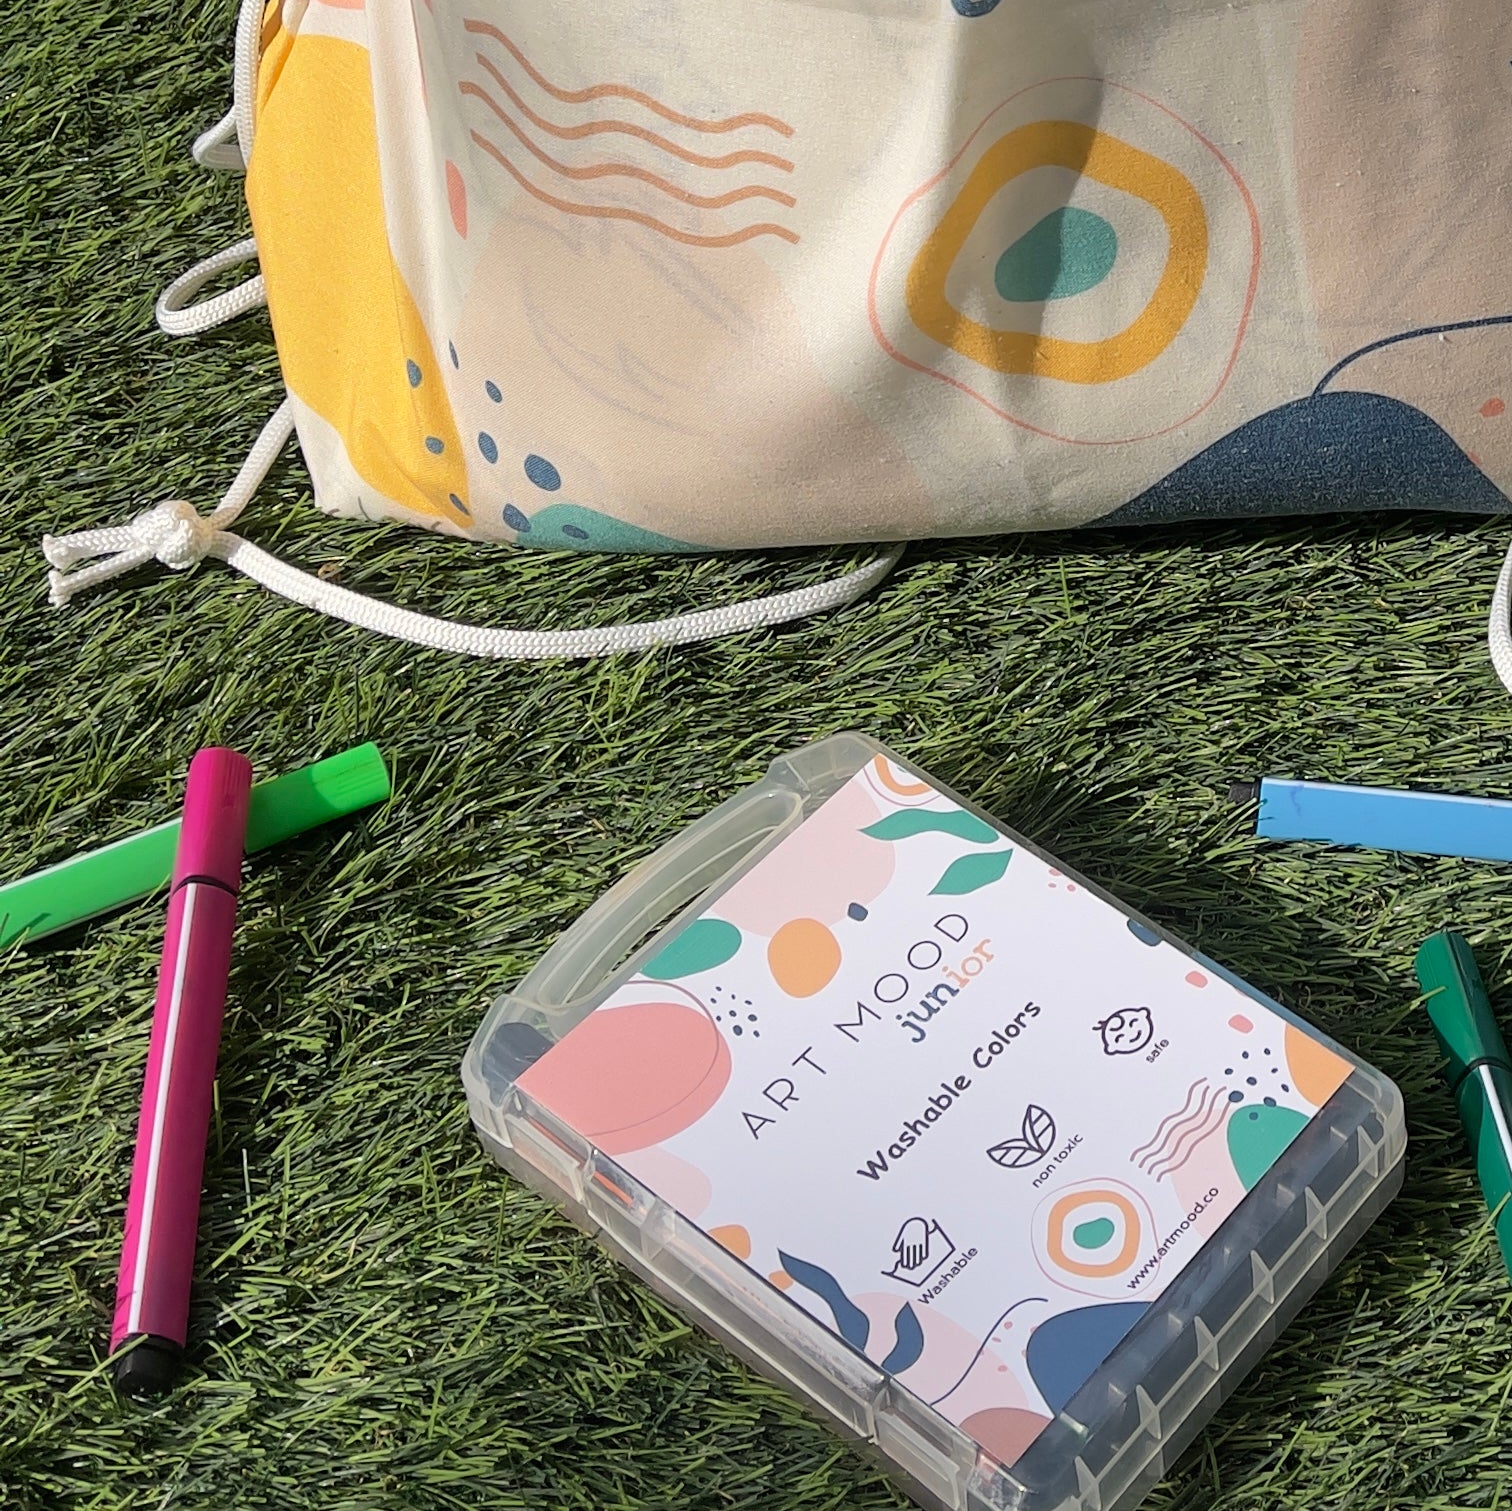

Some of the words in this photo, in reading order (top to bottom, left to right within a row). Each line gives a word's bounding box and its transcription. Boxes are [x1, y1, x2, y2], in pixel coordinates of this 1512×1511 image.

[742, 1046, 827, 1140] ART
[834, 913, 969, 1043] MOOD
[895, 938, 995, 1043] junior
[856, 1074, 972, 1181] Washable
[972, 1001, 1041, 1069] Colors
[1146, 1039, 1170, 1064] safe
[1032, 1164, 1057, 1188] non
[1053, 1134, 1084, 1164] toxic
[917, 1247, 978, 1305] Washable
[1127, 1187, 1219, 1290] www.artmood.co
